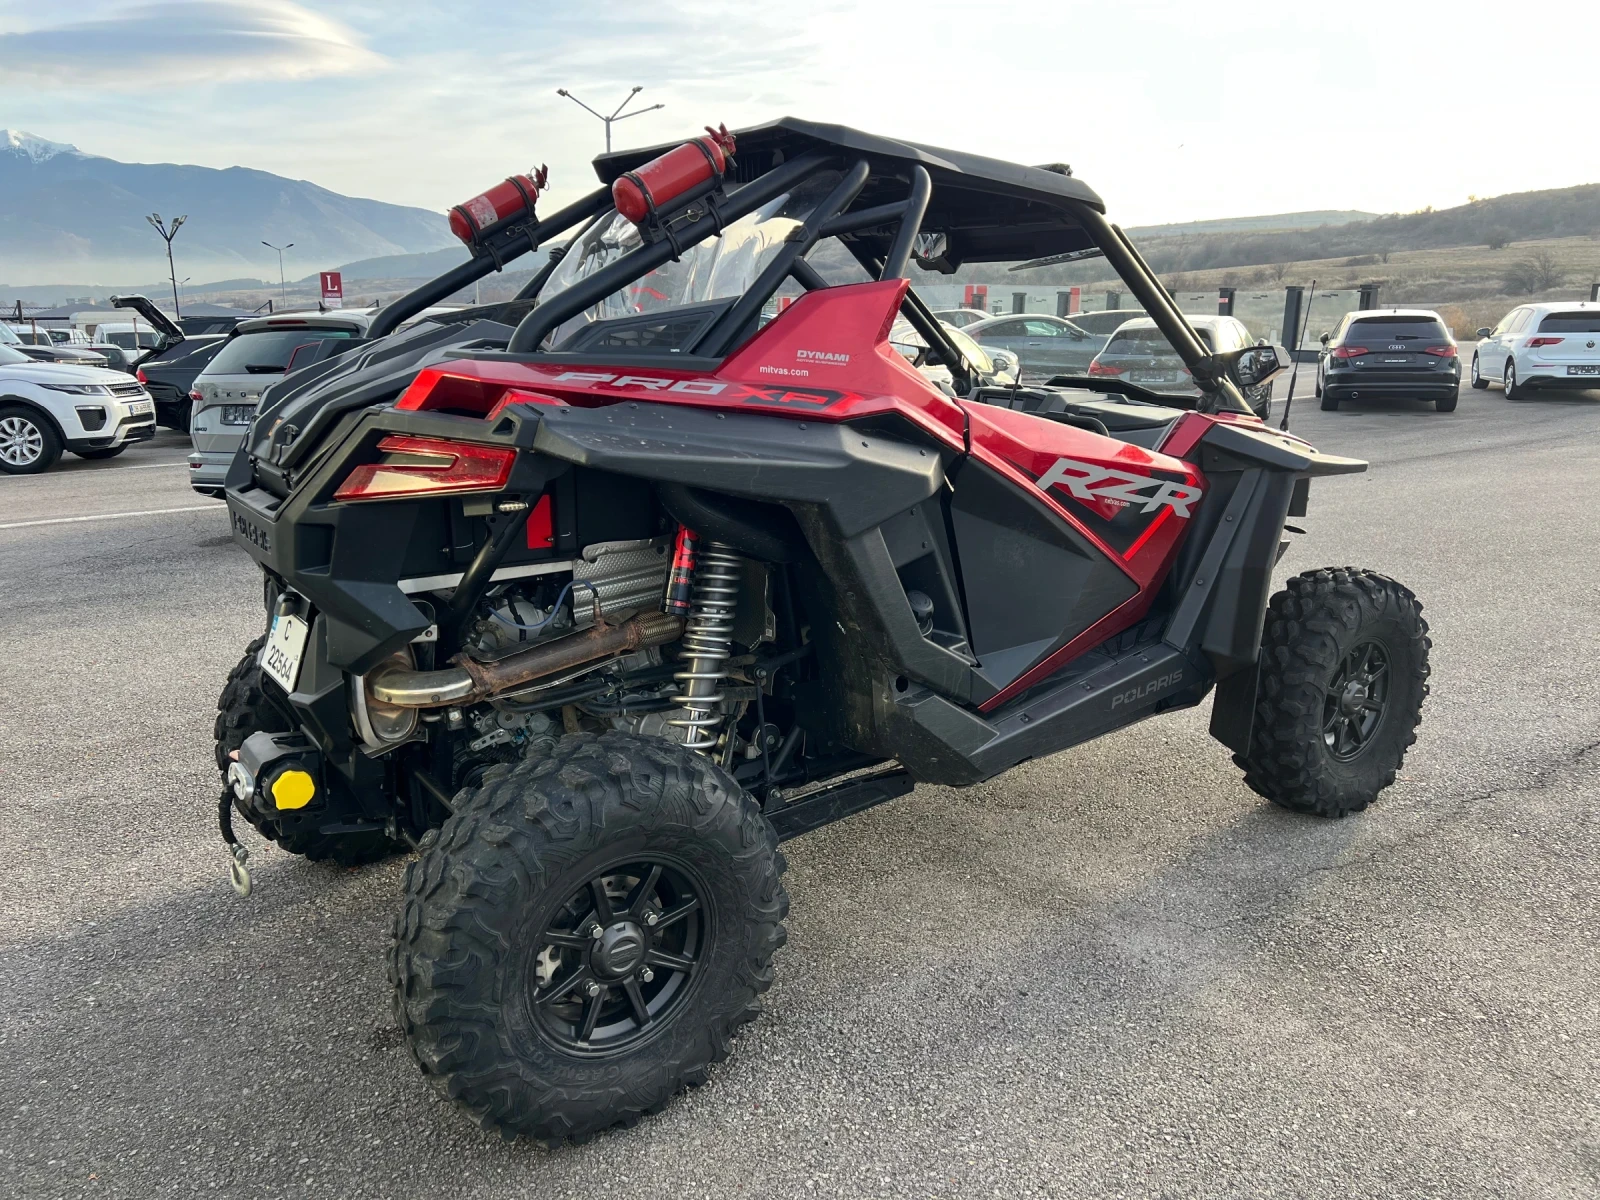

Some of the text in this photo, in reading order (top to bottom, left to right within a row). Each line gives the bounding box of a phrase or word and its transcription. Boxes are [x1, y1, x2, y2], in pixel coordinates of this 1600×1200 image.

[326, 275, 338, 291] L
[552, 371, 829, 405] PRO XP
[760, 365, 809, 377] mitvas.com
[1035, 457, 1202, 519] RZR
[284, 619, 292, 641] C
[267, 644, 293, 683] 22564
[1111, 669, 1183, 710] POLARIS
